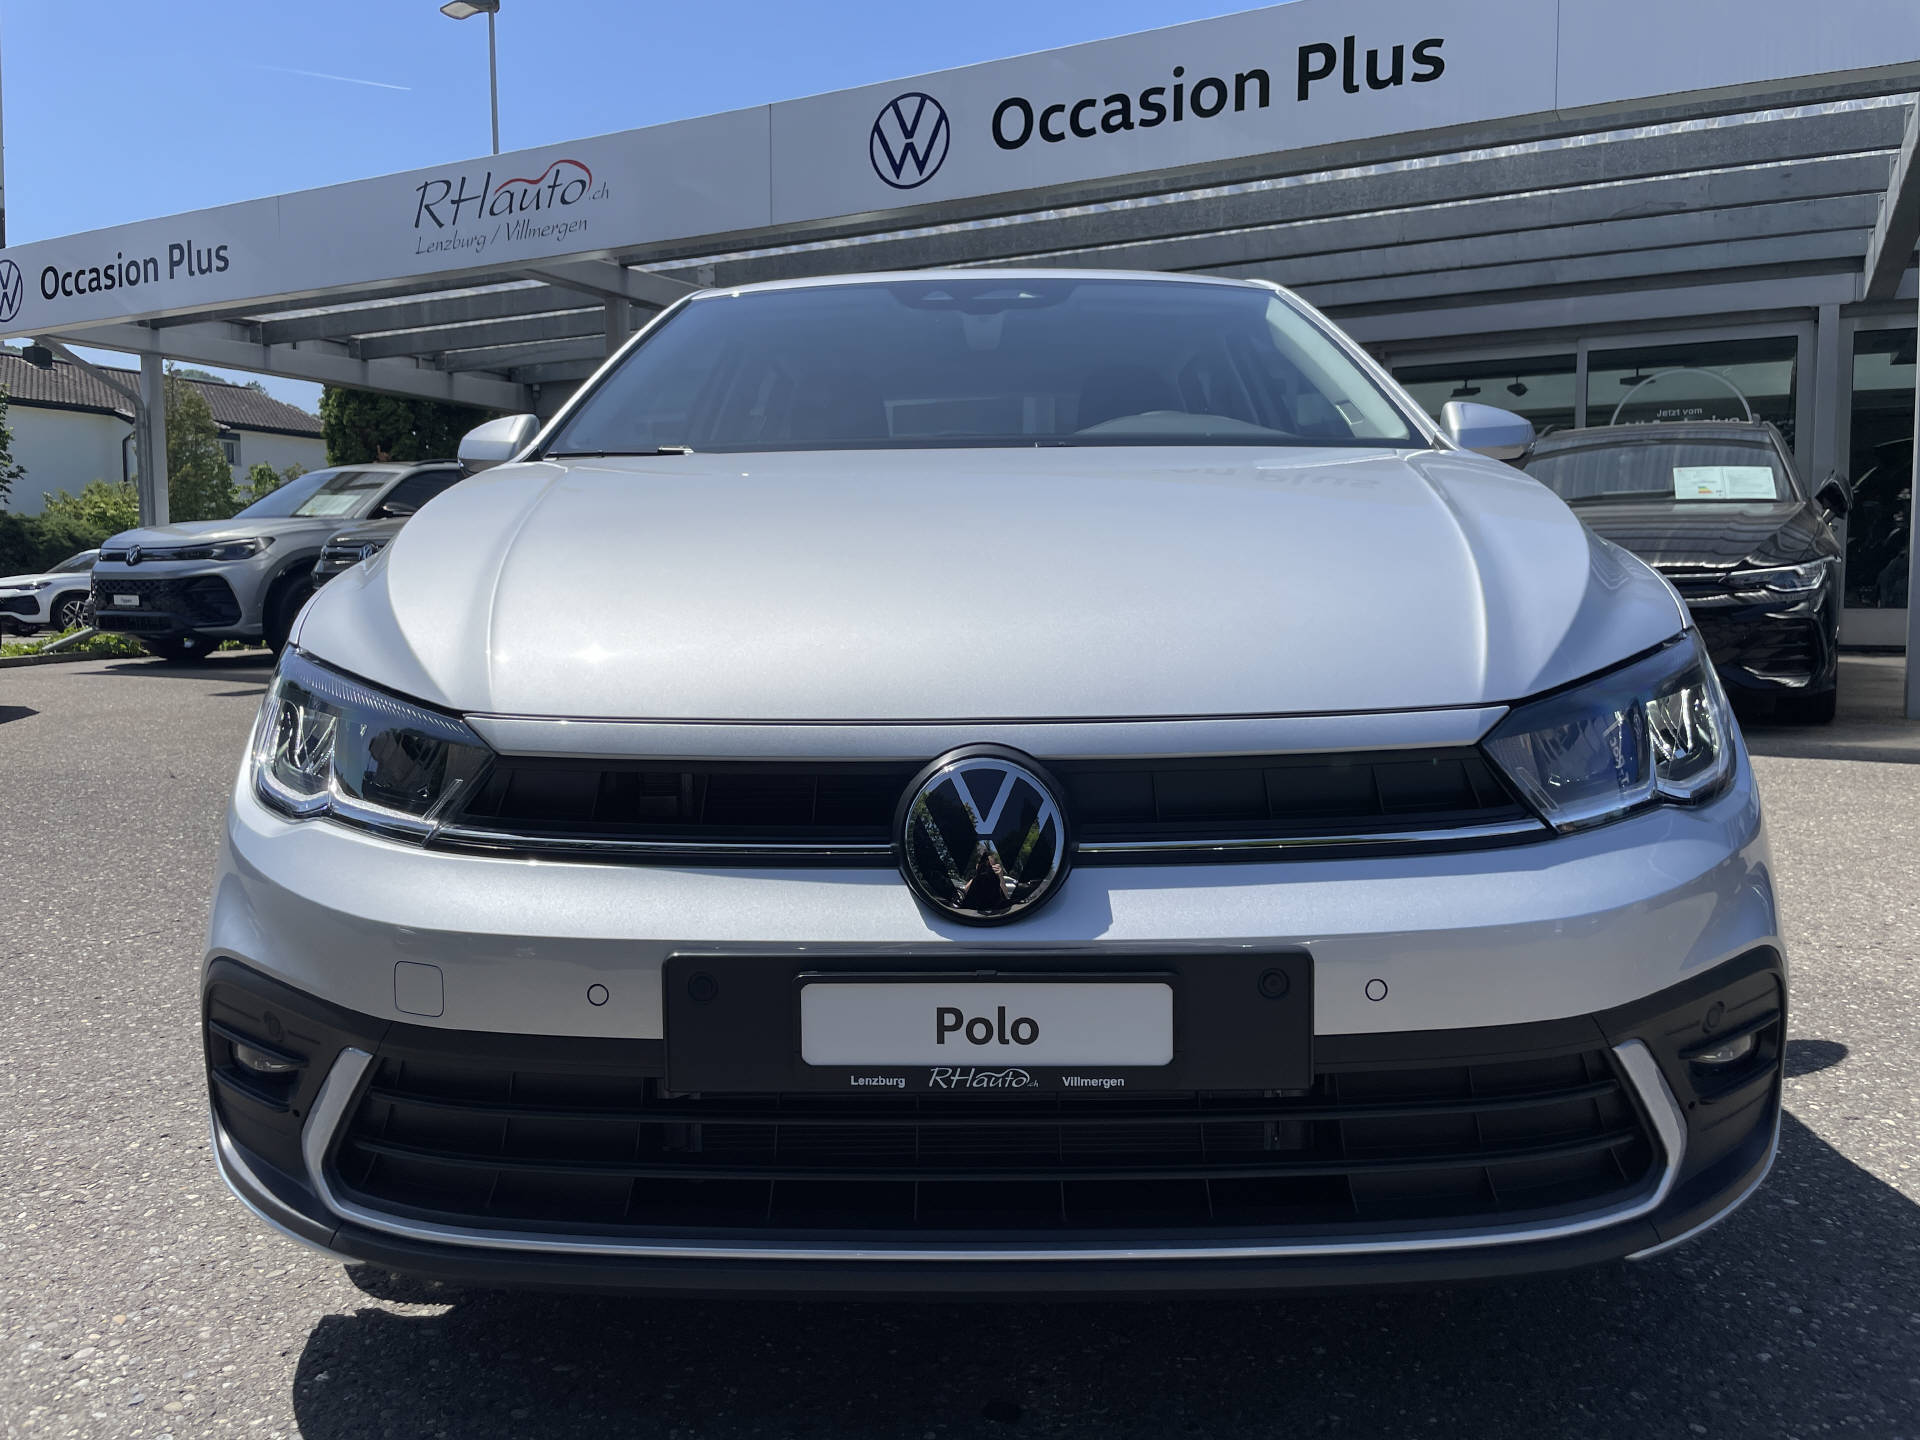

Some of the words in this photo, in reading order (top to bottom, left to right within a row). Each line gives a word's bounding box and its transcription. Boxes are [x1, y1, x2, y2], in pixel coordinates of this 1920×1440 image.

[991, 65, 1271, 151] Occasion
[1297, 34, 1446, 102] Plus
[415, 230, 487, 255] Lenzburg
[505, 217, 588, 242] Villmergen
[40, 252, 159, 301] Occasion
[168, 238, 230, 280] Plus
[1656, 409, 1680, 418] Jetzt
[1682, 407, 1703, 416] vom
[936, 1005, 1040, 1045] Polo
[850, 1075, 906, 1089] Lenzburg
[1062, 1076, 1125, 1089] Villmergen
